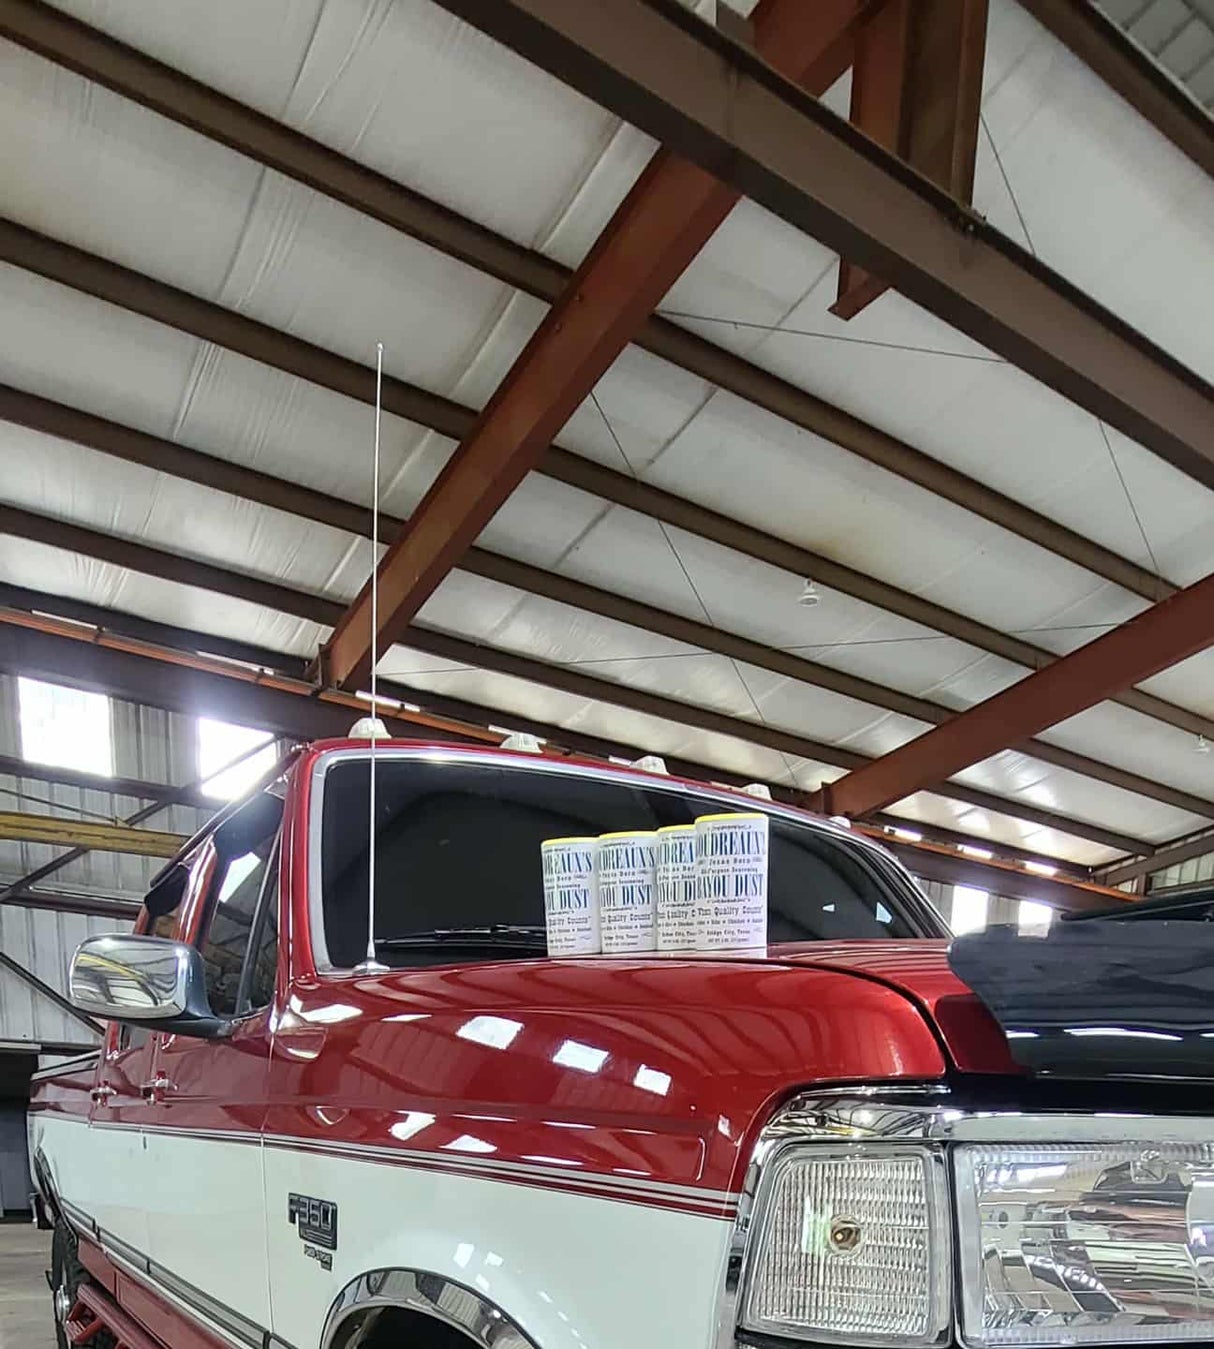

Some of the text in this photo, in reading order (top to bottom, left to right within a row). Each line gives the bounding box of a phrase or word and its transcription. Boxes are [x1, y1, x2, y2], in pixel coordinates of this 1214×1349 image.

[622, 884, 652, 907] DUST
[735, 874, 764, 898] DUST
[559, 888, 590, 909] DUST
